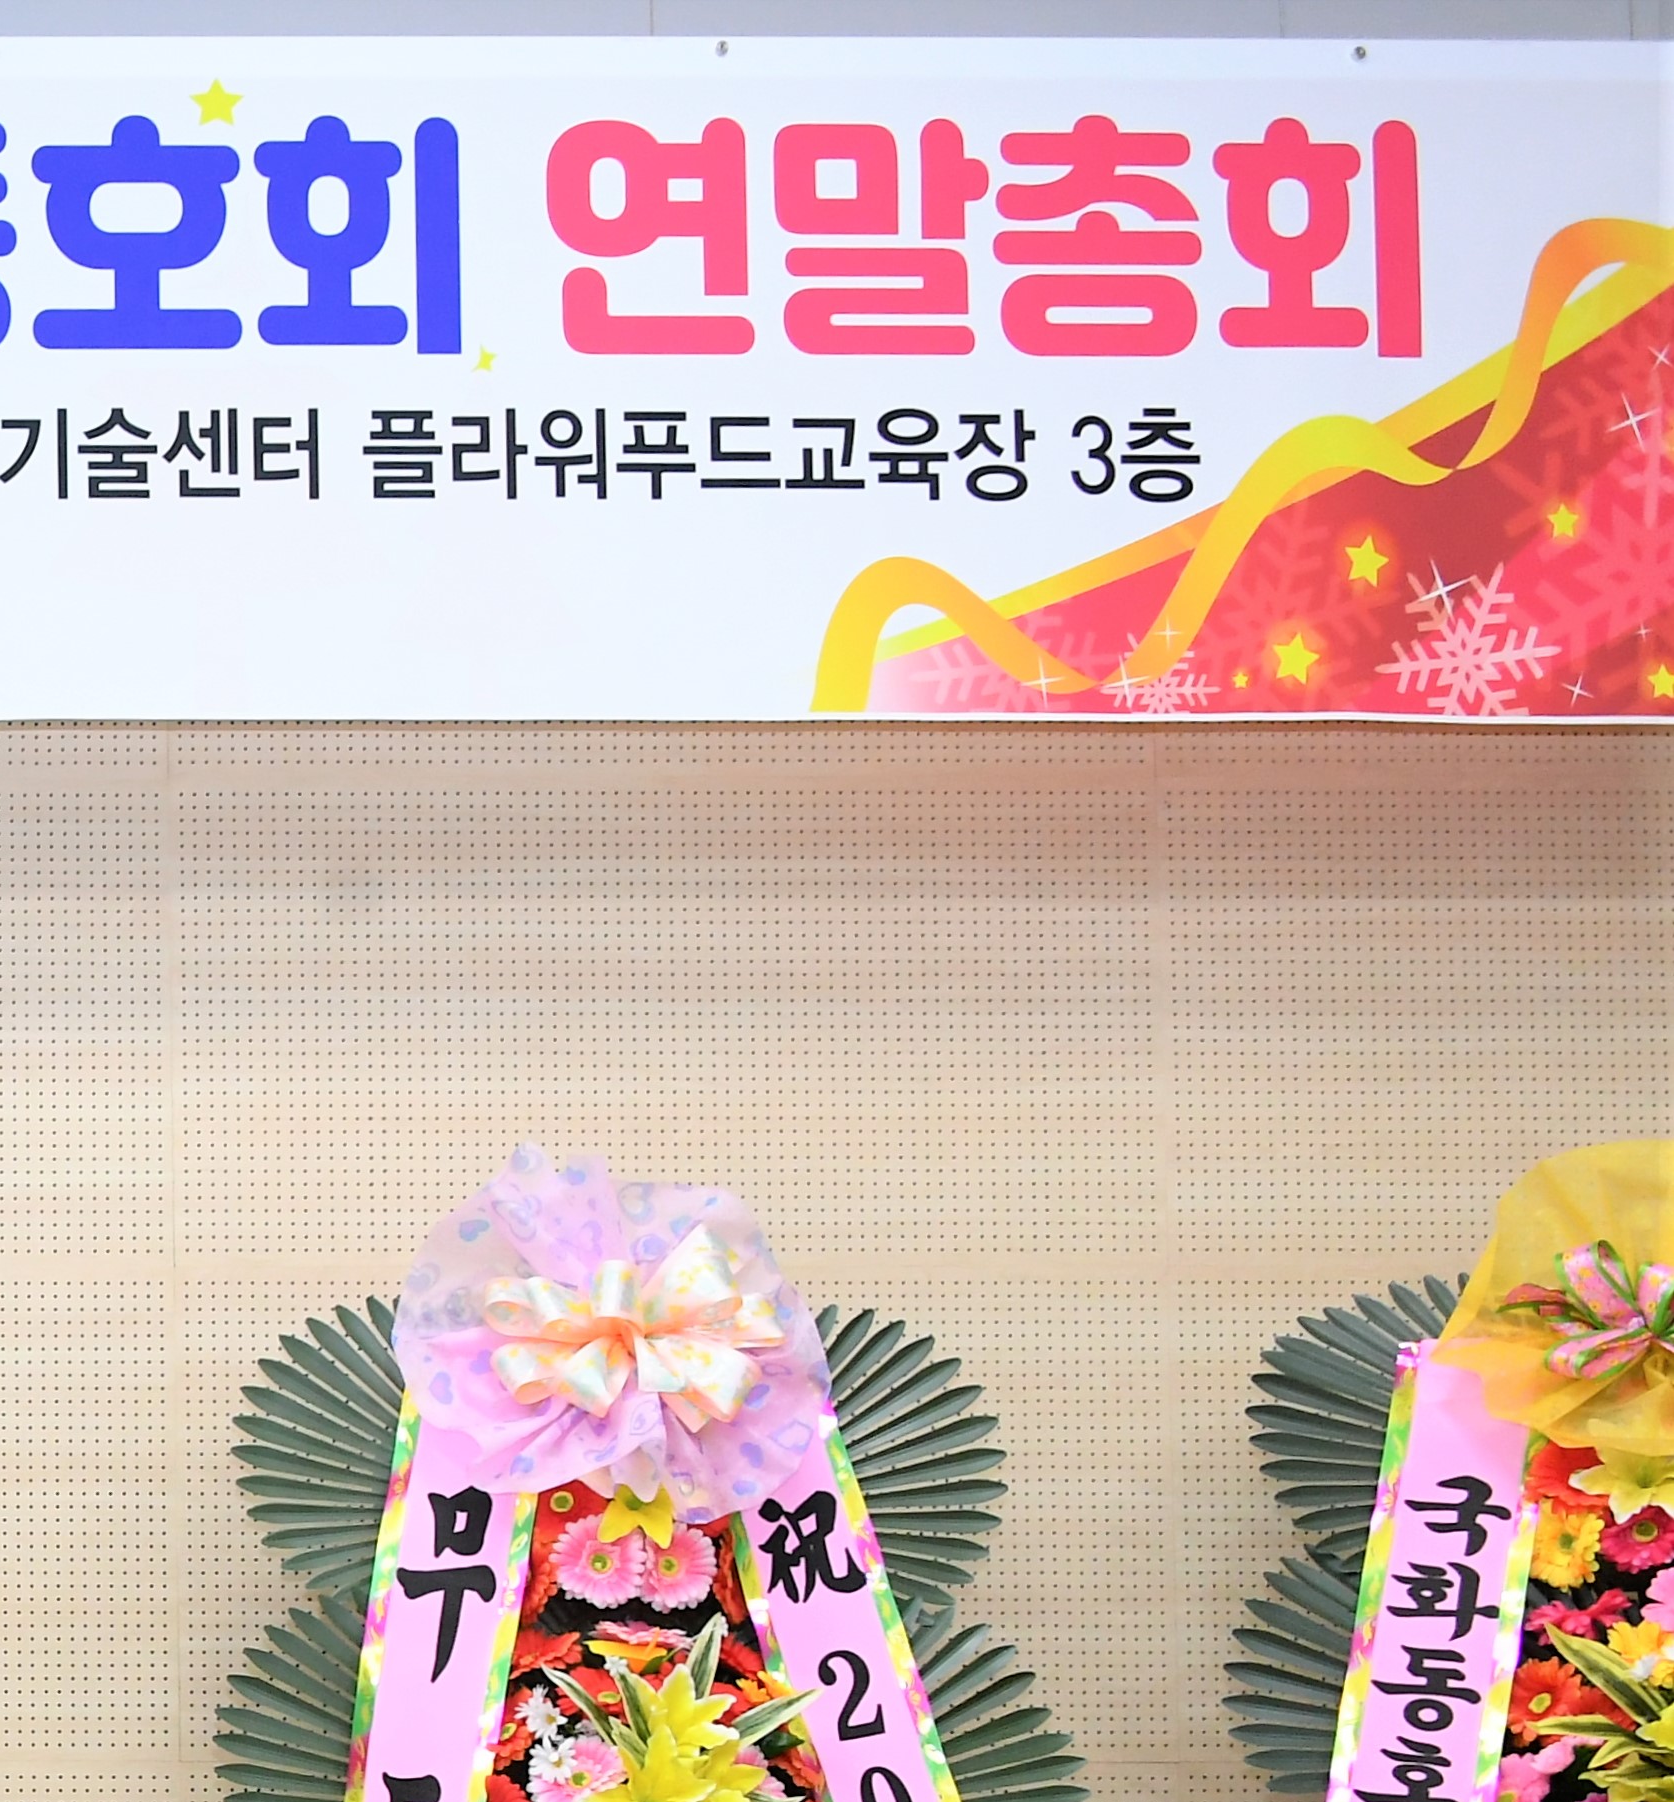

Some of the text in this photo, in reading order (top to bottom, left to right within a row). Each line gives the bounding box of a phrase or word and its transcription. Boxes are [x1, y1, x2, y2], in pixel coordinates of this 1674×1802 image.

[545, 114, 1423, 358] 연말총회
[362, 408, 1036, 502] 플라워푸드교육장
[1070, 408, 1201, 503] 3층
[758, 1490, 867, 1604] 祝
